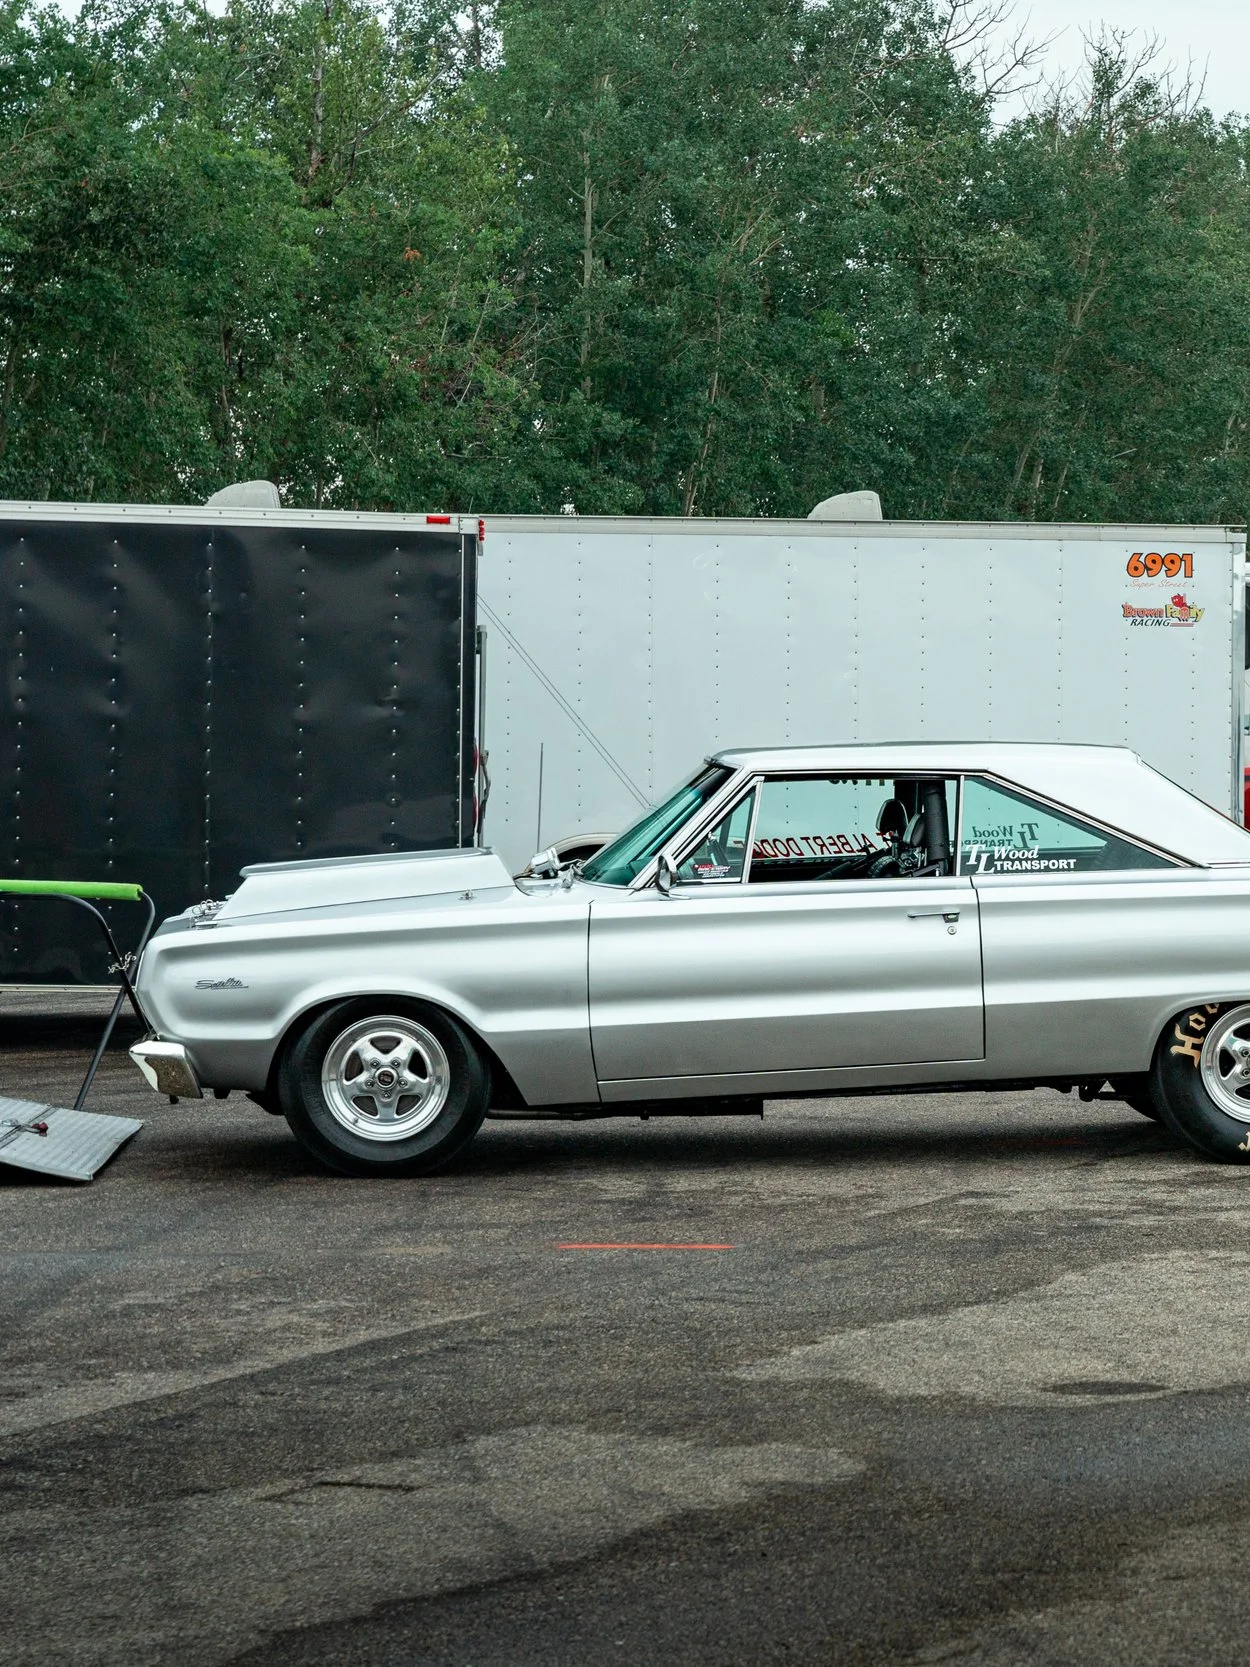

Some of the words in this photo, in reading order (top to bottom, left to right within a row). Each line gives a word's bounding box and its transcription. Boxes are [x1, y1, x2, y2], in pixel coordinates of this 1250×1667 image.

[1127, 553, 1193, 578] 6991
[1130, 579, 1155, 589] Super
[1158, 579, 1189, 588] Street
[1122, 604, 1164, 618] Brown
[1130, 619, 1171, 627] RACING
[993, 845, 1039, 860] Wood
[994, 859, 1077, 870] TRANSPORT
